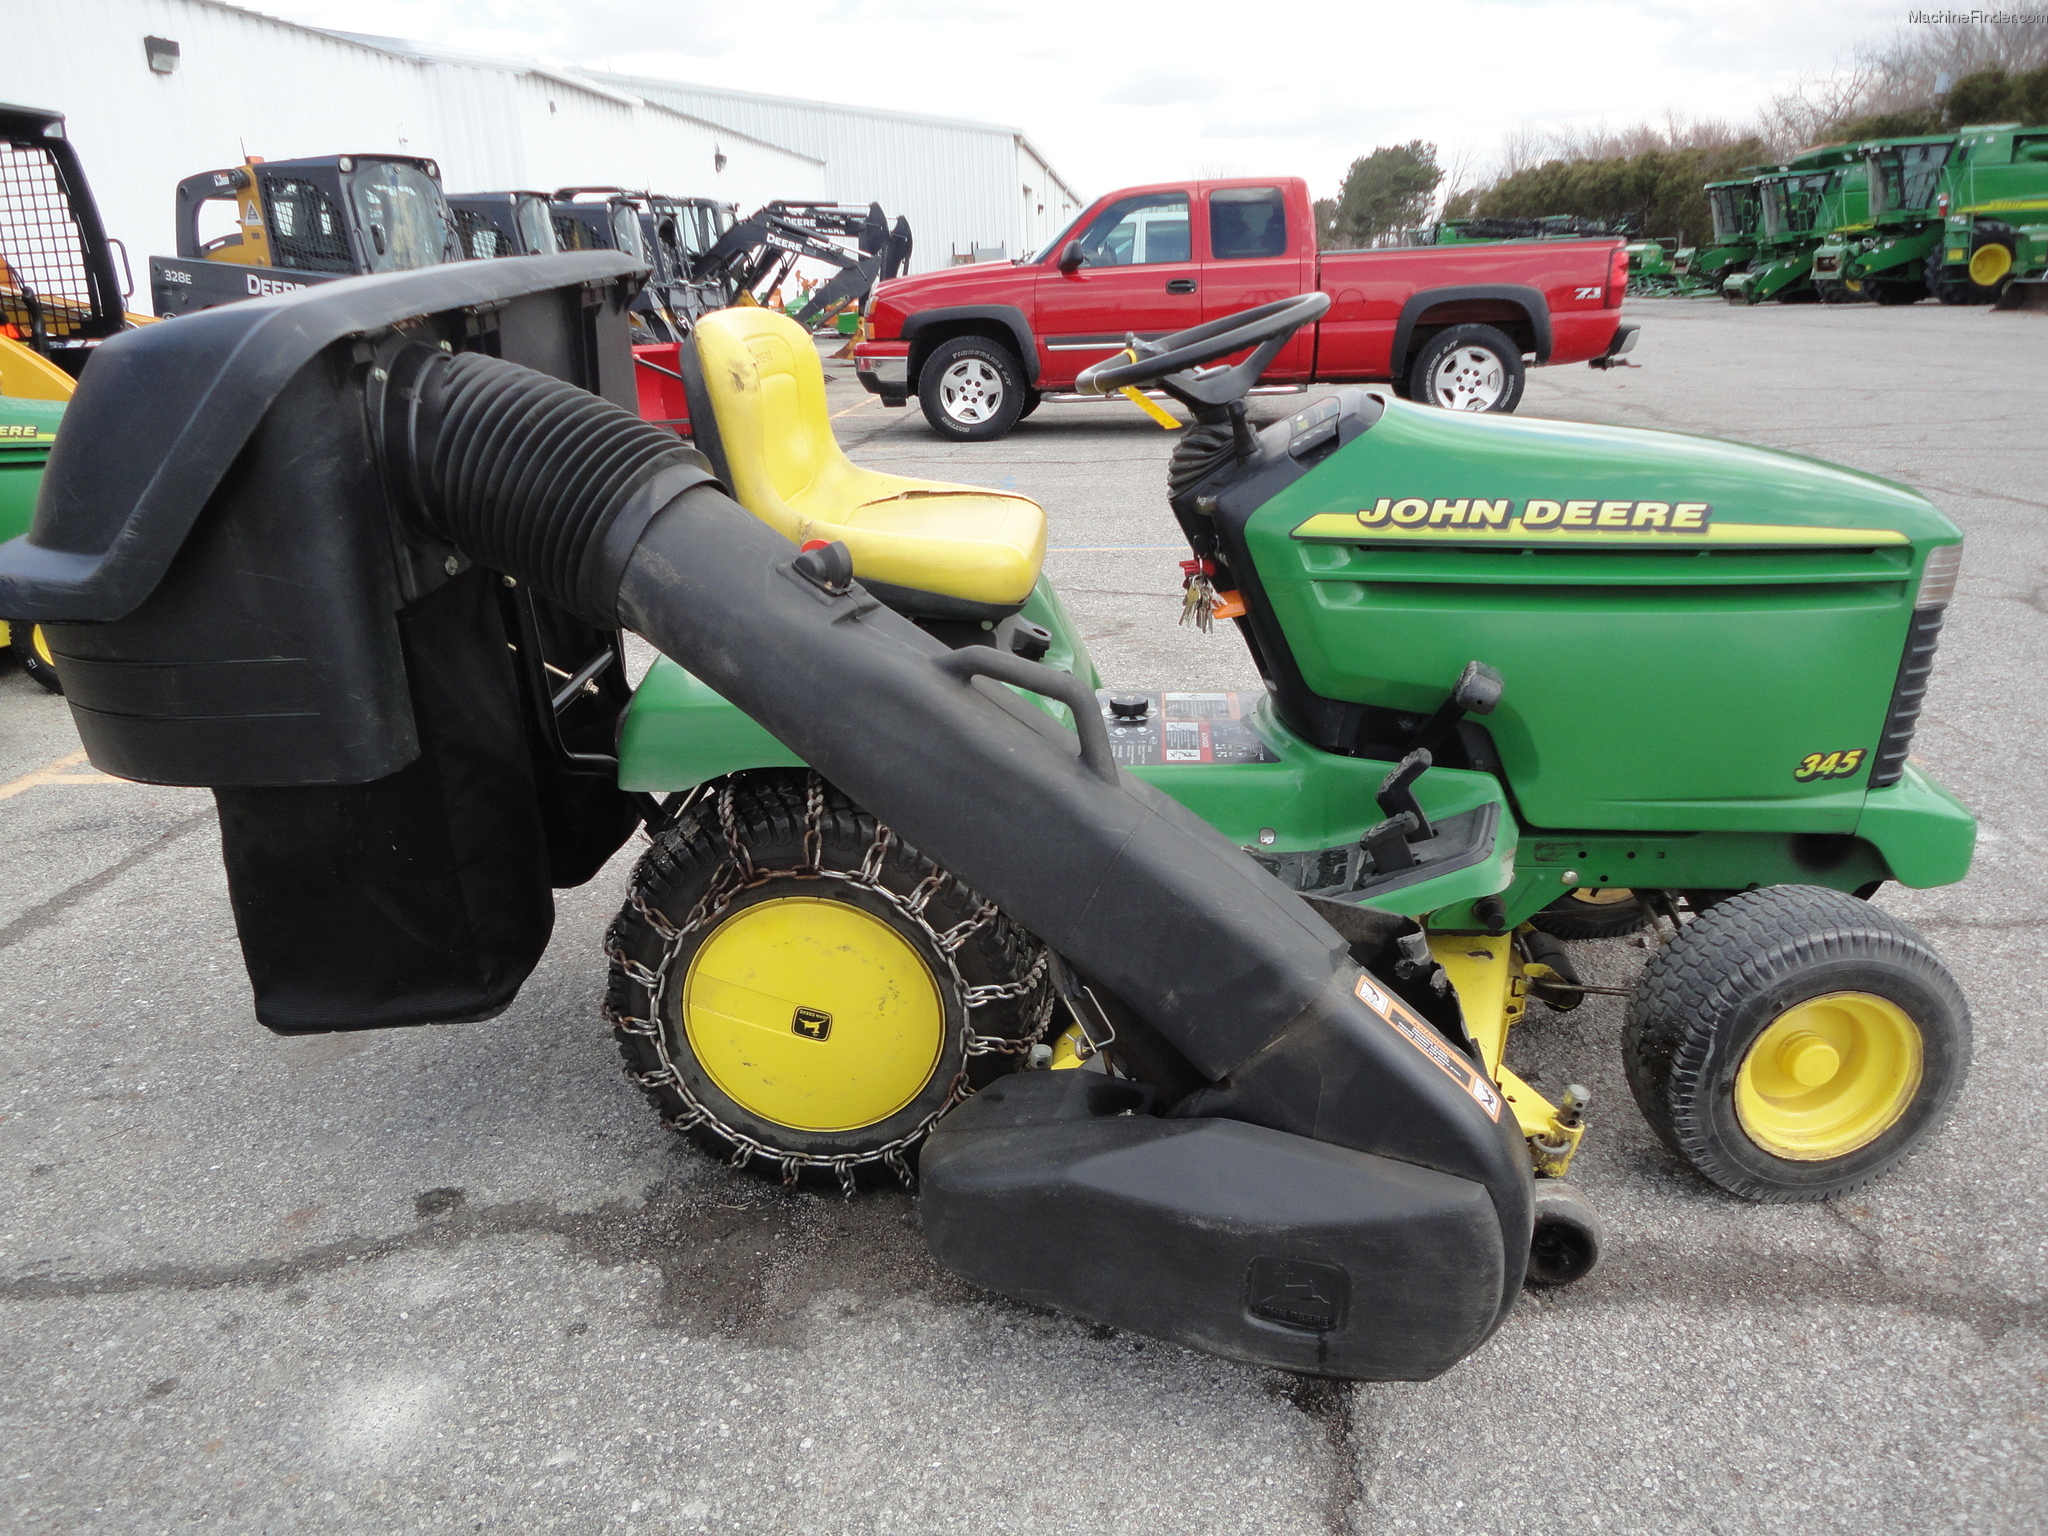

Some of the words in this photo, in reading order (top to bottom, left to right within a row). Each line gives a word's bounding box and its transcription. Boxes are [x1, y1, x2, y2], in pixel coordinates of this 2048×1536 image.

[783, 216, 817, 228] DEERE
[766, 232, 803, 253] DEERE
[164, 269, 193, 285] 328E
[1357, 498, 1512, 527] JOHN
[1521, 500, 1710, 531] DEERE
[1794, 749, 1865, 780] 345
